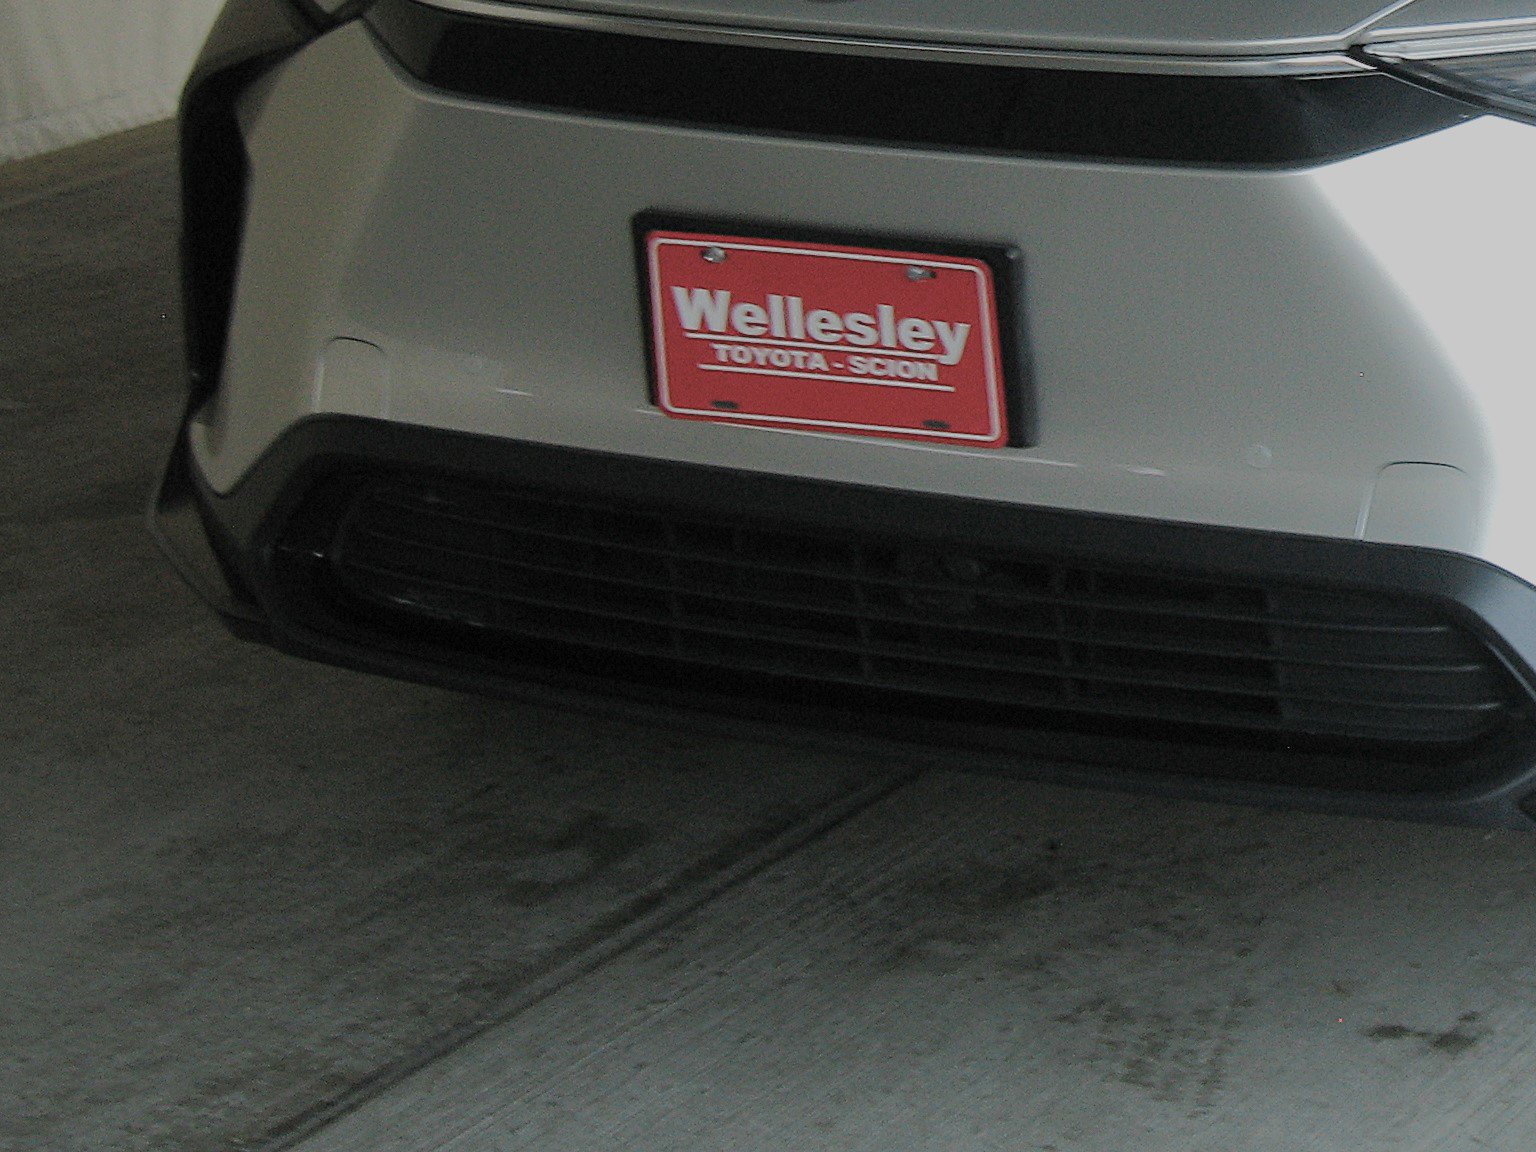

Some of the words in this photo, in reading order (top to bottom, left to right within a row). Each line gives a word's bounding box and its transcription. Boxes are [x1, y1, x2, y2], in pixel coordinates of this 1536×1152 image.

[671, 286, 971, 365] Wellesley
[711, 344, 829, 371] TOYOTA
[848, 357, 939, 381] SCION
